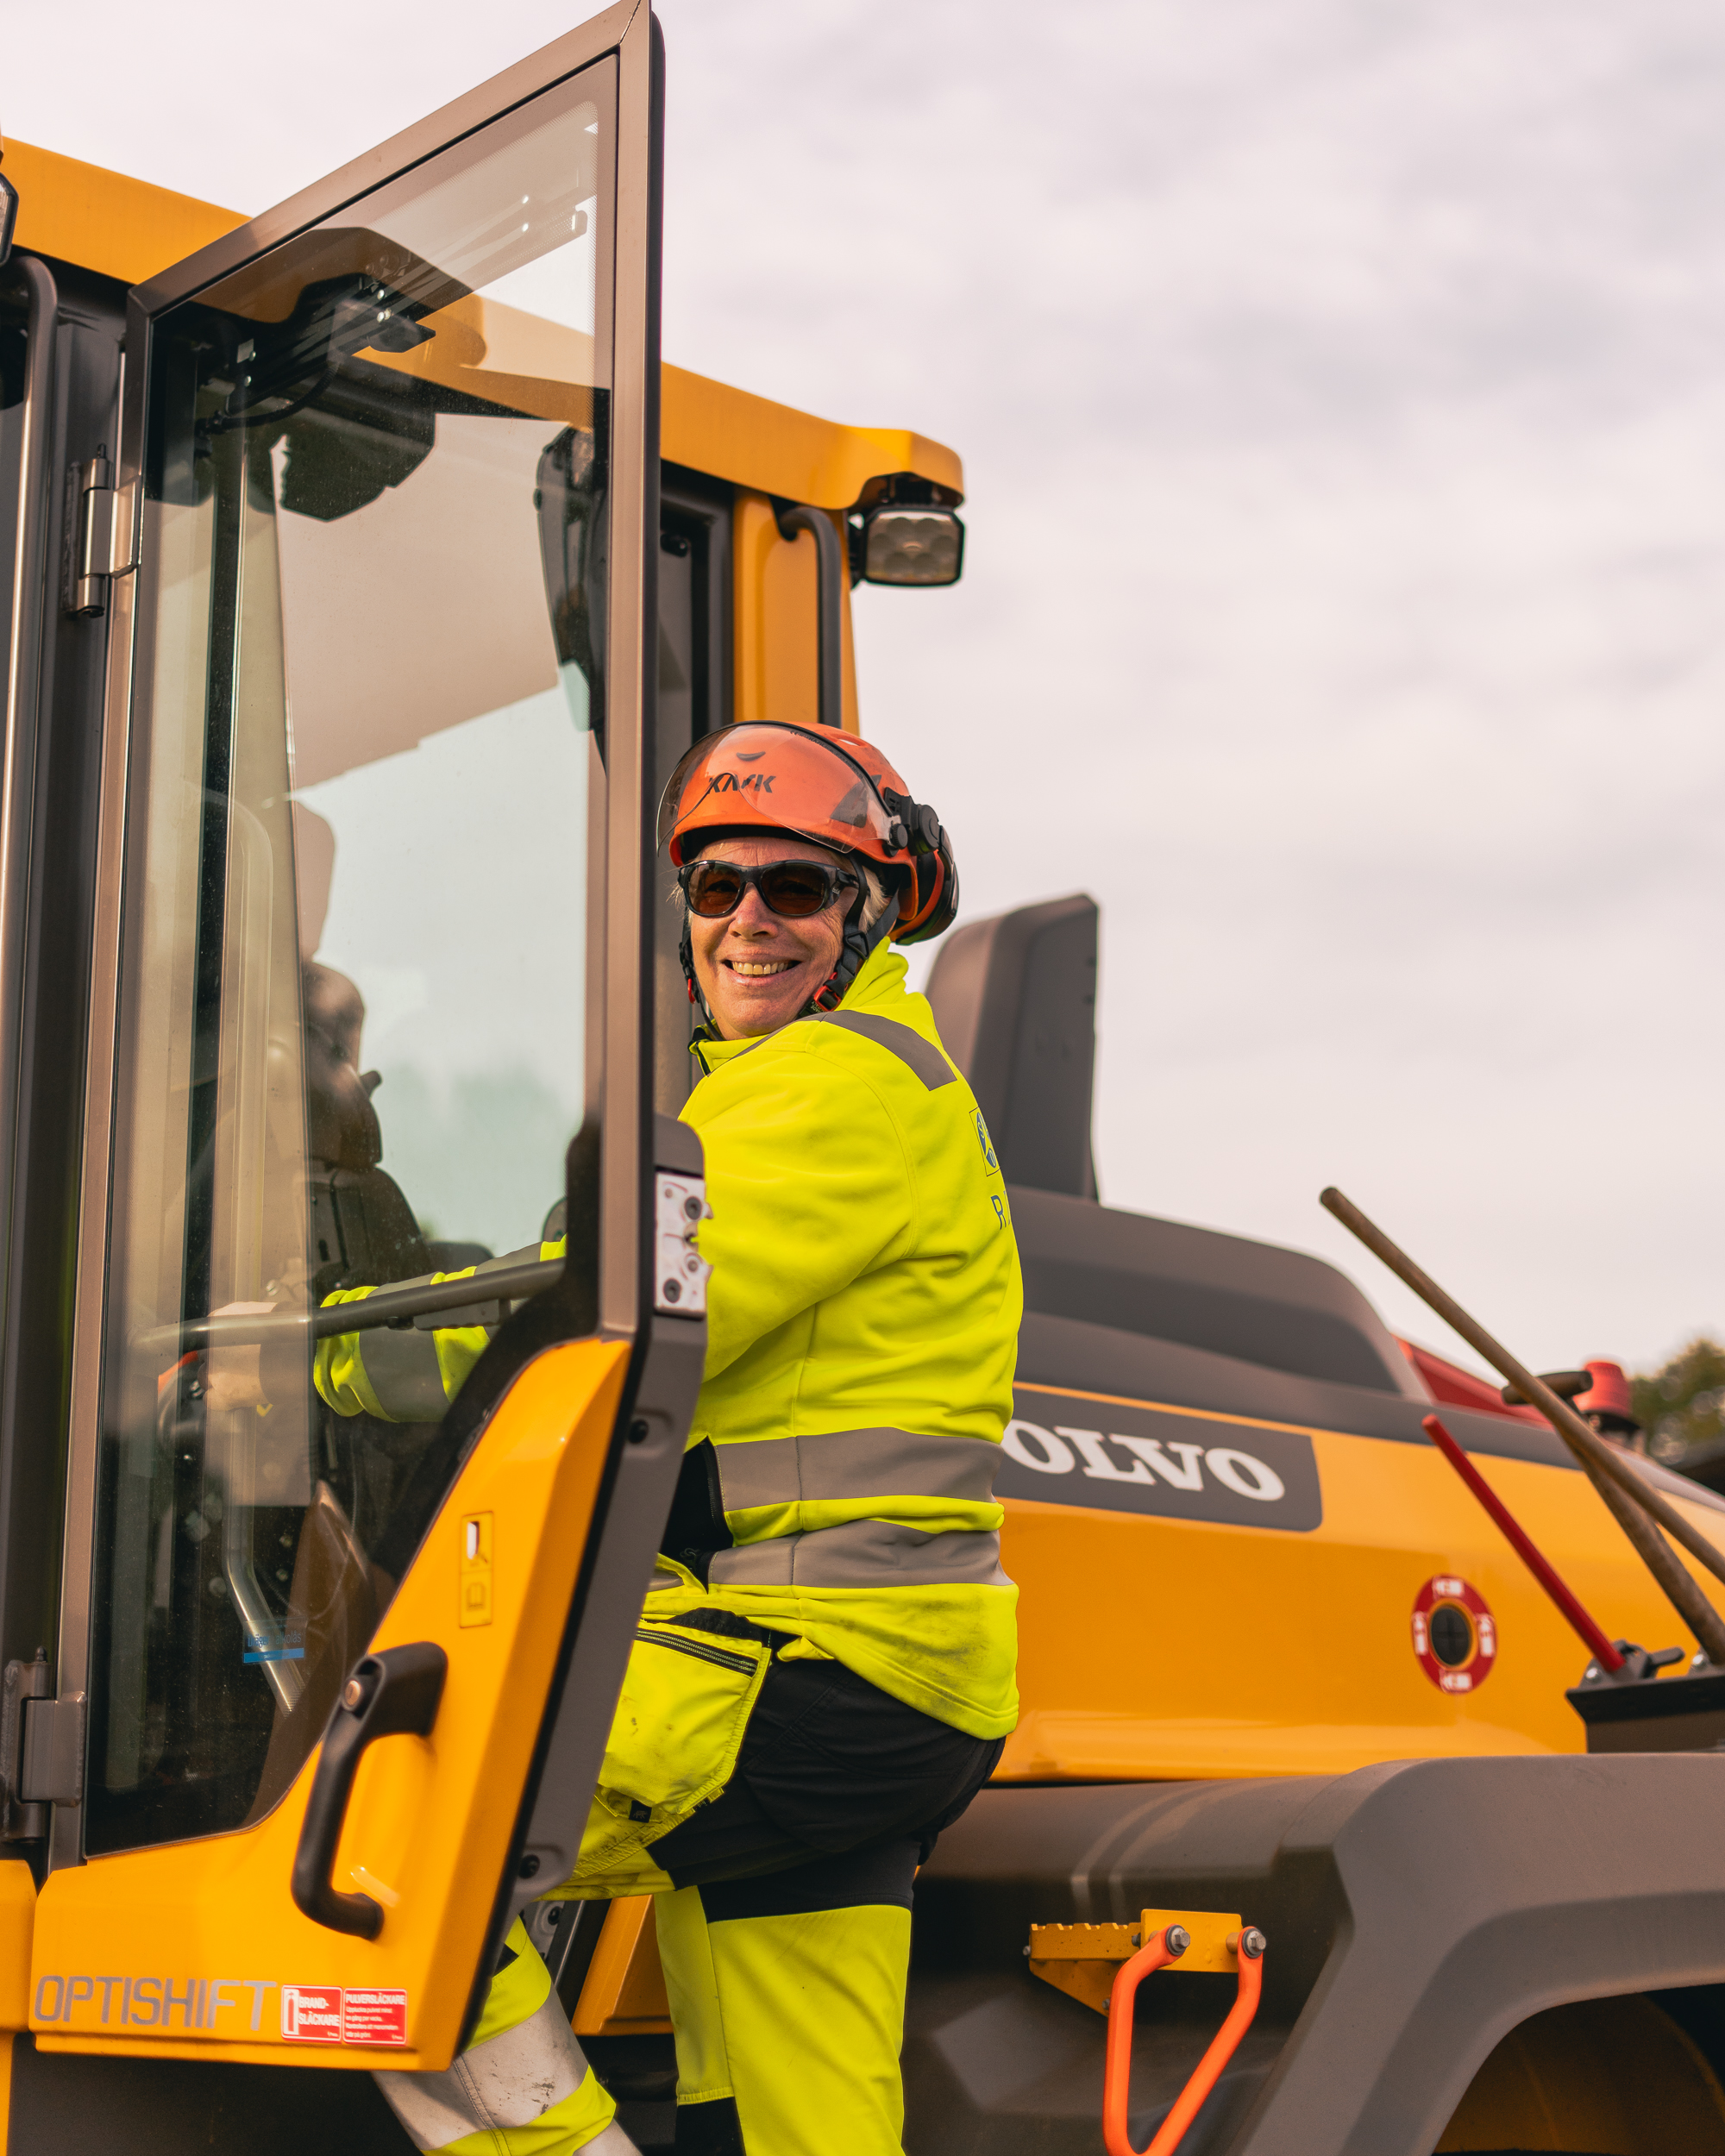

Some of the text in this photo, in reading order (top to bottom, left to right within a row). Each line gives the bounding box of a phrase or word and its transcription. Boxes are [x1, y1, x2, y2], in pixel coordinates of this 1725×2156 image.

[1001, 1419, 1285, 1501] OLVO
[34, 1975, 278, 2031] OPTISHIFT
[298, 1996, 329, 2009] BRAND-
[345, 1992, 405, 2005] PULVERSLÄCKARE
[298, 2011, 340, 2027] SLÄCKARE
